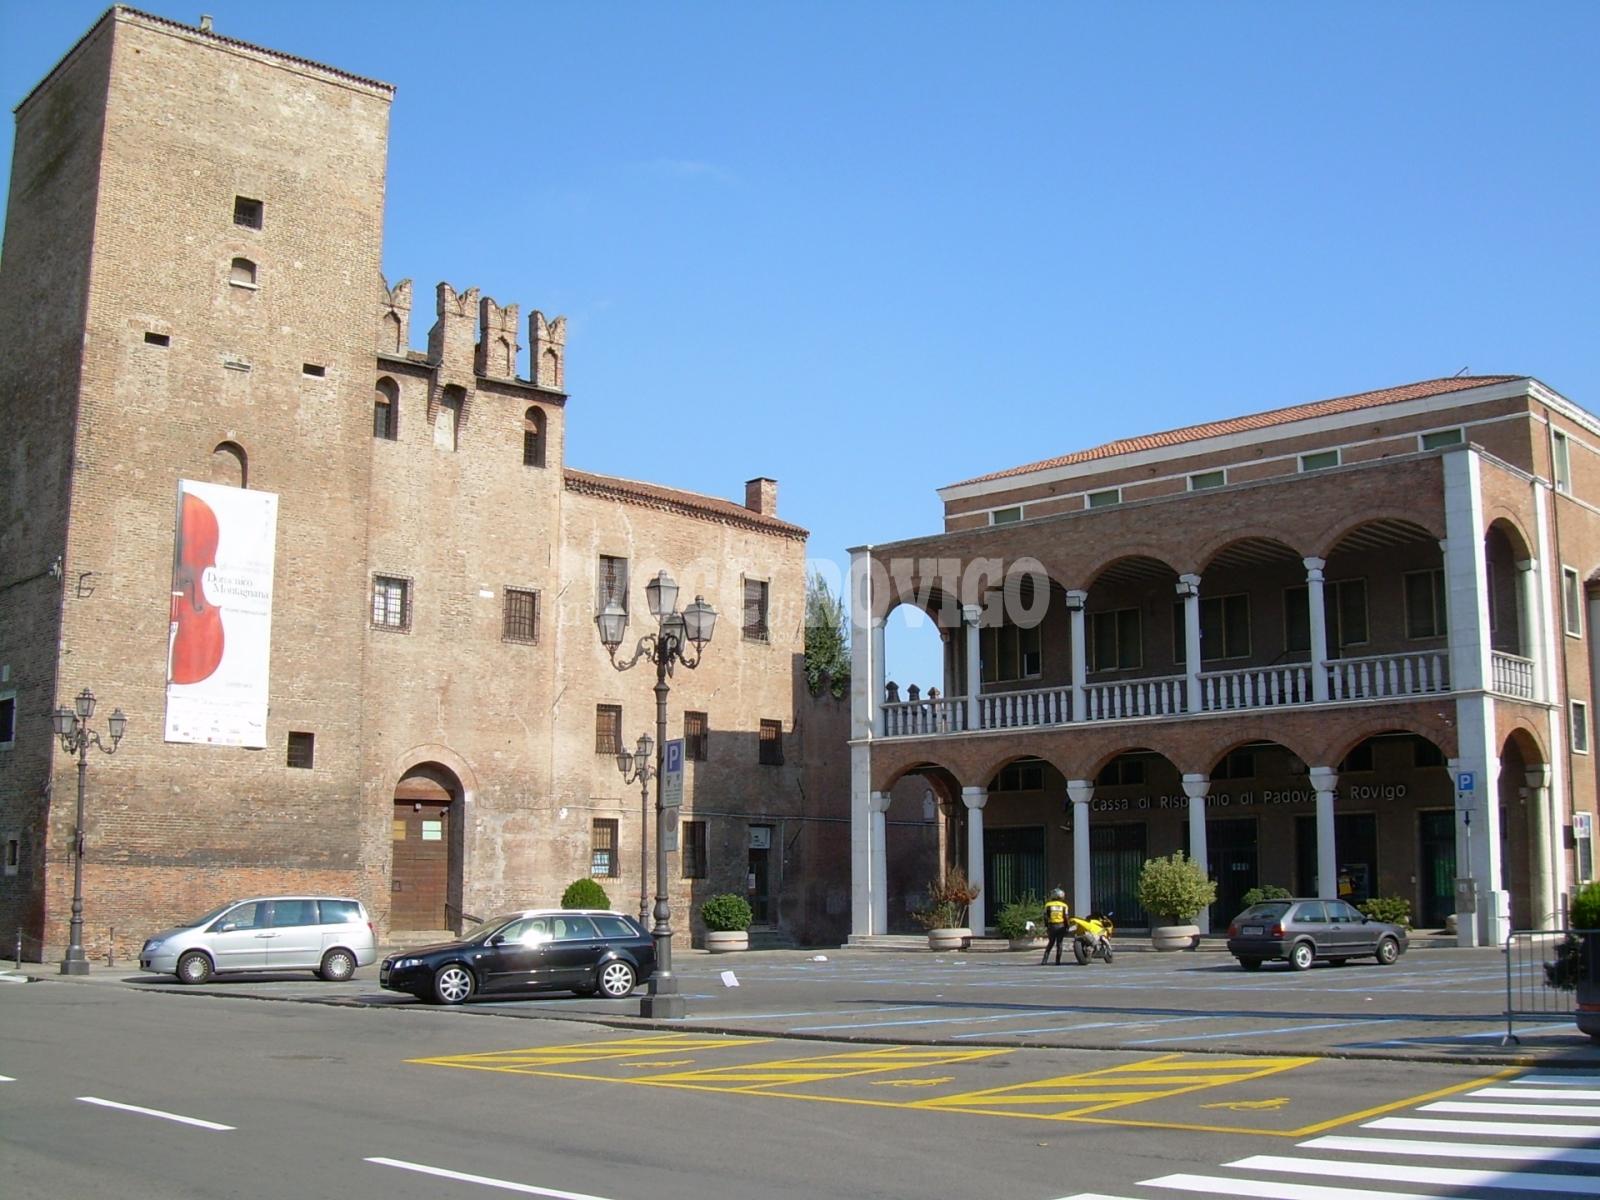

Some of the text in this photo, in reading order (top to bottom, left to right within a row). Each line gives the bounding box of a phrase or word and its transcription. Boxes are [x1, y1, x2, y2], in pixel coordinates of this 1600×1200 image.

[669, 745, 679, 770] P
[1460, 774, 1471, 789] P
[1092, 797, 1129, 811] Cassa
[1138, 794, 1150, 809] di
[1161, 794, 1230, 809] Rispmio
[1241, 791, 1254, 805] di
[1264, 789, 1317, 804] Padova
[1350, 784, 1407, 801] Rovigo
